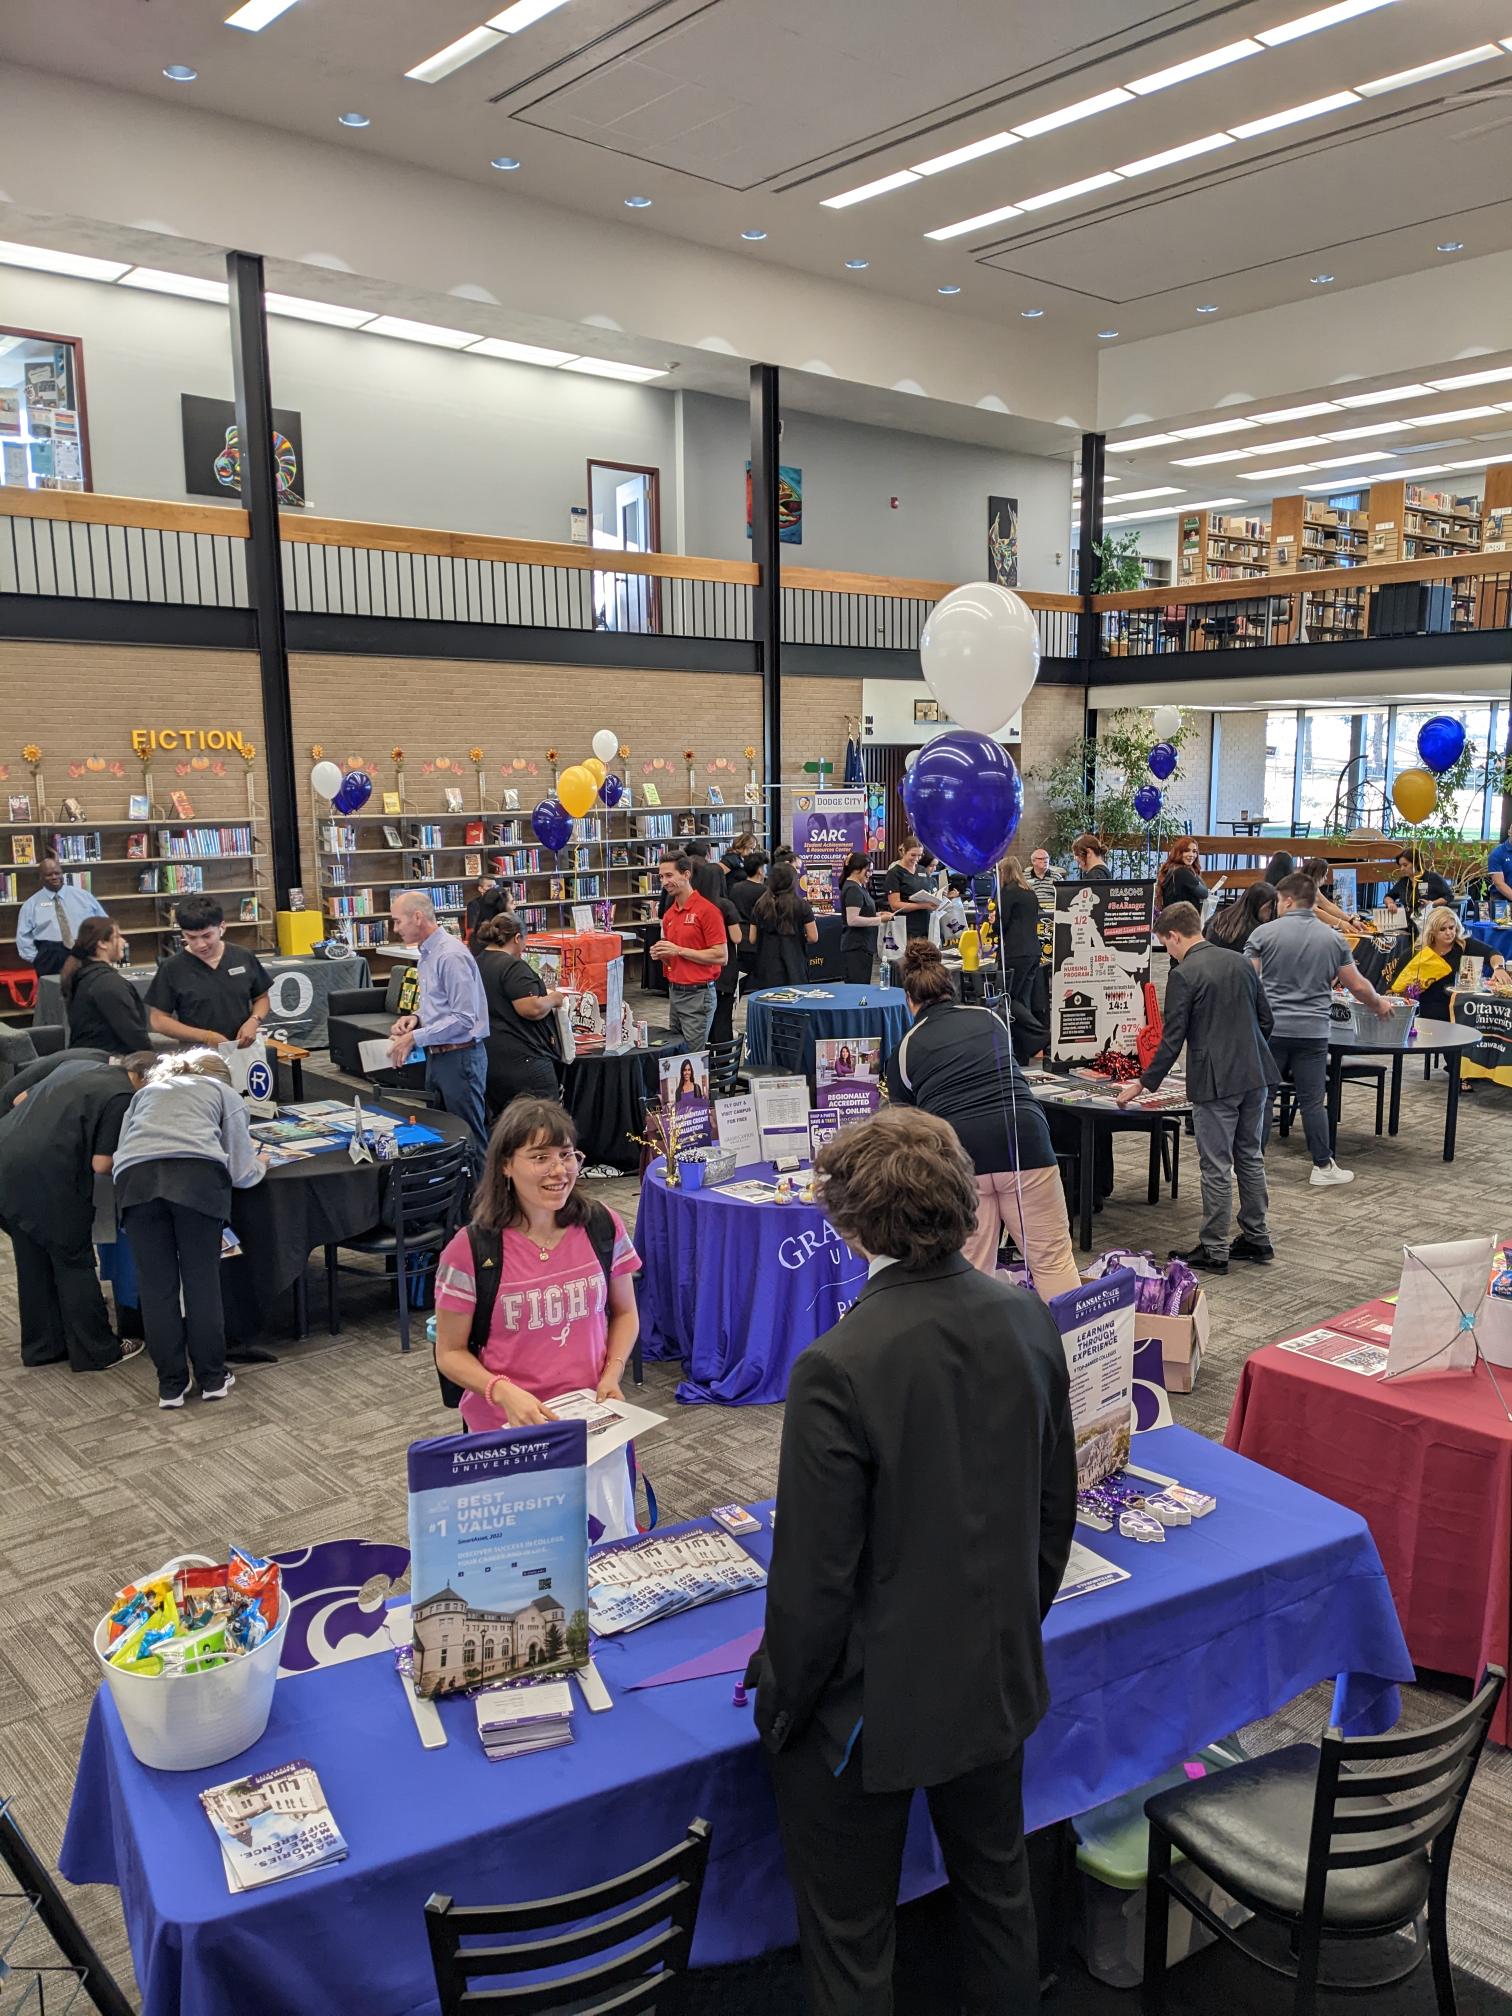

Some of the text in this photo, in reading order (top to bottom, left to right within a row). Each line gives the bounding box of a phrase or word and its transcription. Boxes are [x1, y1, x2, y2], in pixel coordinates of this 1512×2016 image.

[131, 729, 244, 750] FICTION
[817, 797, 862, 806] DODGE CITY
[810, 829, 847, 842] SARC
[1109, 887, 1144, 897] REASONS
[1074, 915, 1088, 925] 1/2
[1094, 955, 1109, 963] 18th
[1108, 1001, 1129, 1010] 14:1
[1463, 1001, 1511, 1018] Ottawa
[827, 1092, 871, 1101] REGIONALLY
[828, 1099, 870, 1107] ACCREDITED
[733, 1107, 751, 1115] CAMPUS
[845, 1107, 871, 1115] ONLINE
[778, 1219, 843, 1270] GRA
[501, 1272, 606, 1331] FIGHT
[1075, 1295, 1102, 1312] KANSAS
[1077, 1320, 1115, 1343] LEARNING
[1077, 1329, 1115, 1351] THROUGH
[1072, 1335, 1118, 1363] EXPERIENCE
[452, 1442, 550, 1464] KANSAS STATE
[452, 1452, 549, 1474] UNIVERSITY
[457, 1491, 504, 1509] BEST
[457, 1494, 566, 1521] UNIVERSITY
[429, 1519, 448, 1537] #1
[457, 1514, 517, 1534] VALUE
[627, 1588, 656, 1607] MAKE
[637, 1595, 665, 1613] MAKE
[240, 1821, 328, 1859] DIFFERENCE.
[289, 1827, 331, 1849] MAKE
[254, 1832, 335, 1868] MEMORIES.
[296, 1838, 338, 1861] MAKE
